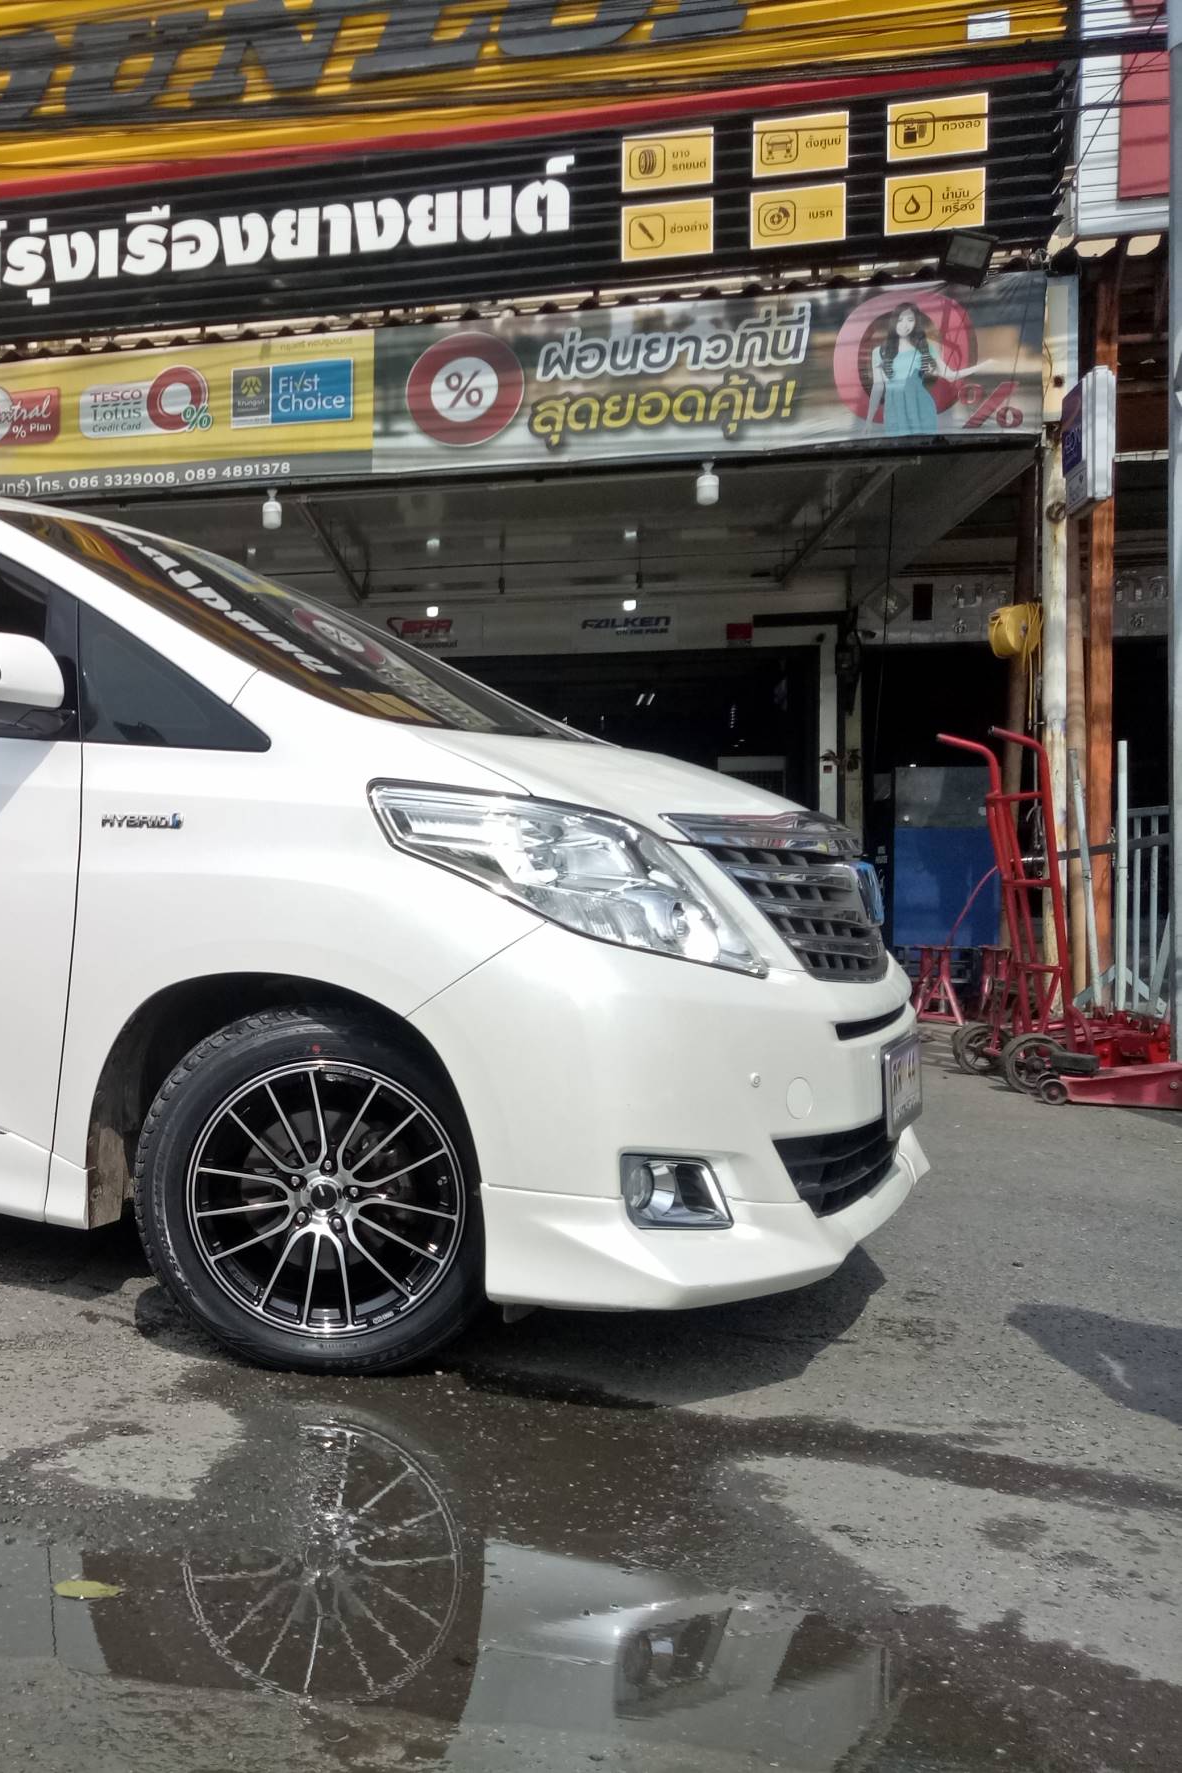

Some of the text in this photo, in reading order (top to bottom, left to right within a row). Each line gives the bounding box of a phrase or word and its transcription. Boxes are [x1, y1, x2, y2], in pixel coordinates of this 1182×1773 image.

[941, 117, 981, 131] ถวงลอ
[671, 149, 690, 159] ยาง
[671, 158, 707, 172] รถยนต์
[941, 185, 970, 200] น้ำมัน
[808, 208, 834, 219] เบรก
[940, 199, 975, 214] เครื่อง
[670, 221, 709, 234] ช่วงล่าง
[537, 303, 810, 381] ผ่อนยาวที่นี่
[90, 388, 143, 404] TESCO
[277, 392, 346, 413] Choice
[91, 405, 142, 422] Lotus
[530, 376, 798, 446] สุดยอดคุ้ม!
[29, 422, 51, 434] Plan
[91, 421, 142, 434] Credit Card
[68, 475, 99, 489] 086
[104, 470, 179, 487] 3329008,
[184, 466, 216, 482] 089
[222, 461, 291, 479] 4891378
[580, 615, 671, 632] FALKEN
[101, 814, 170, 829] HYBRID
